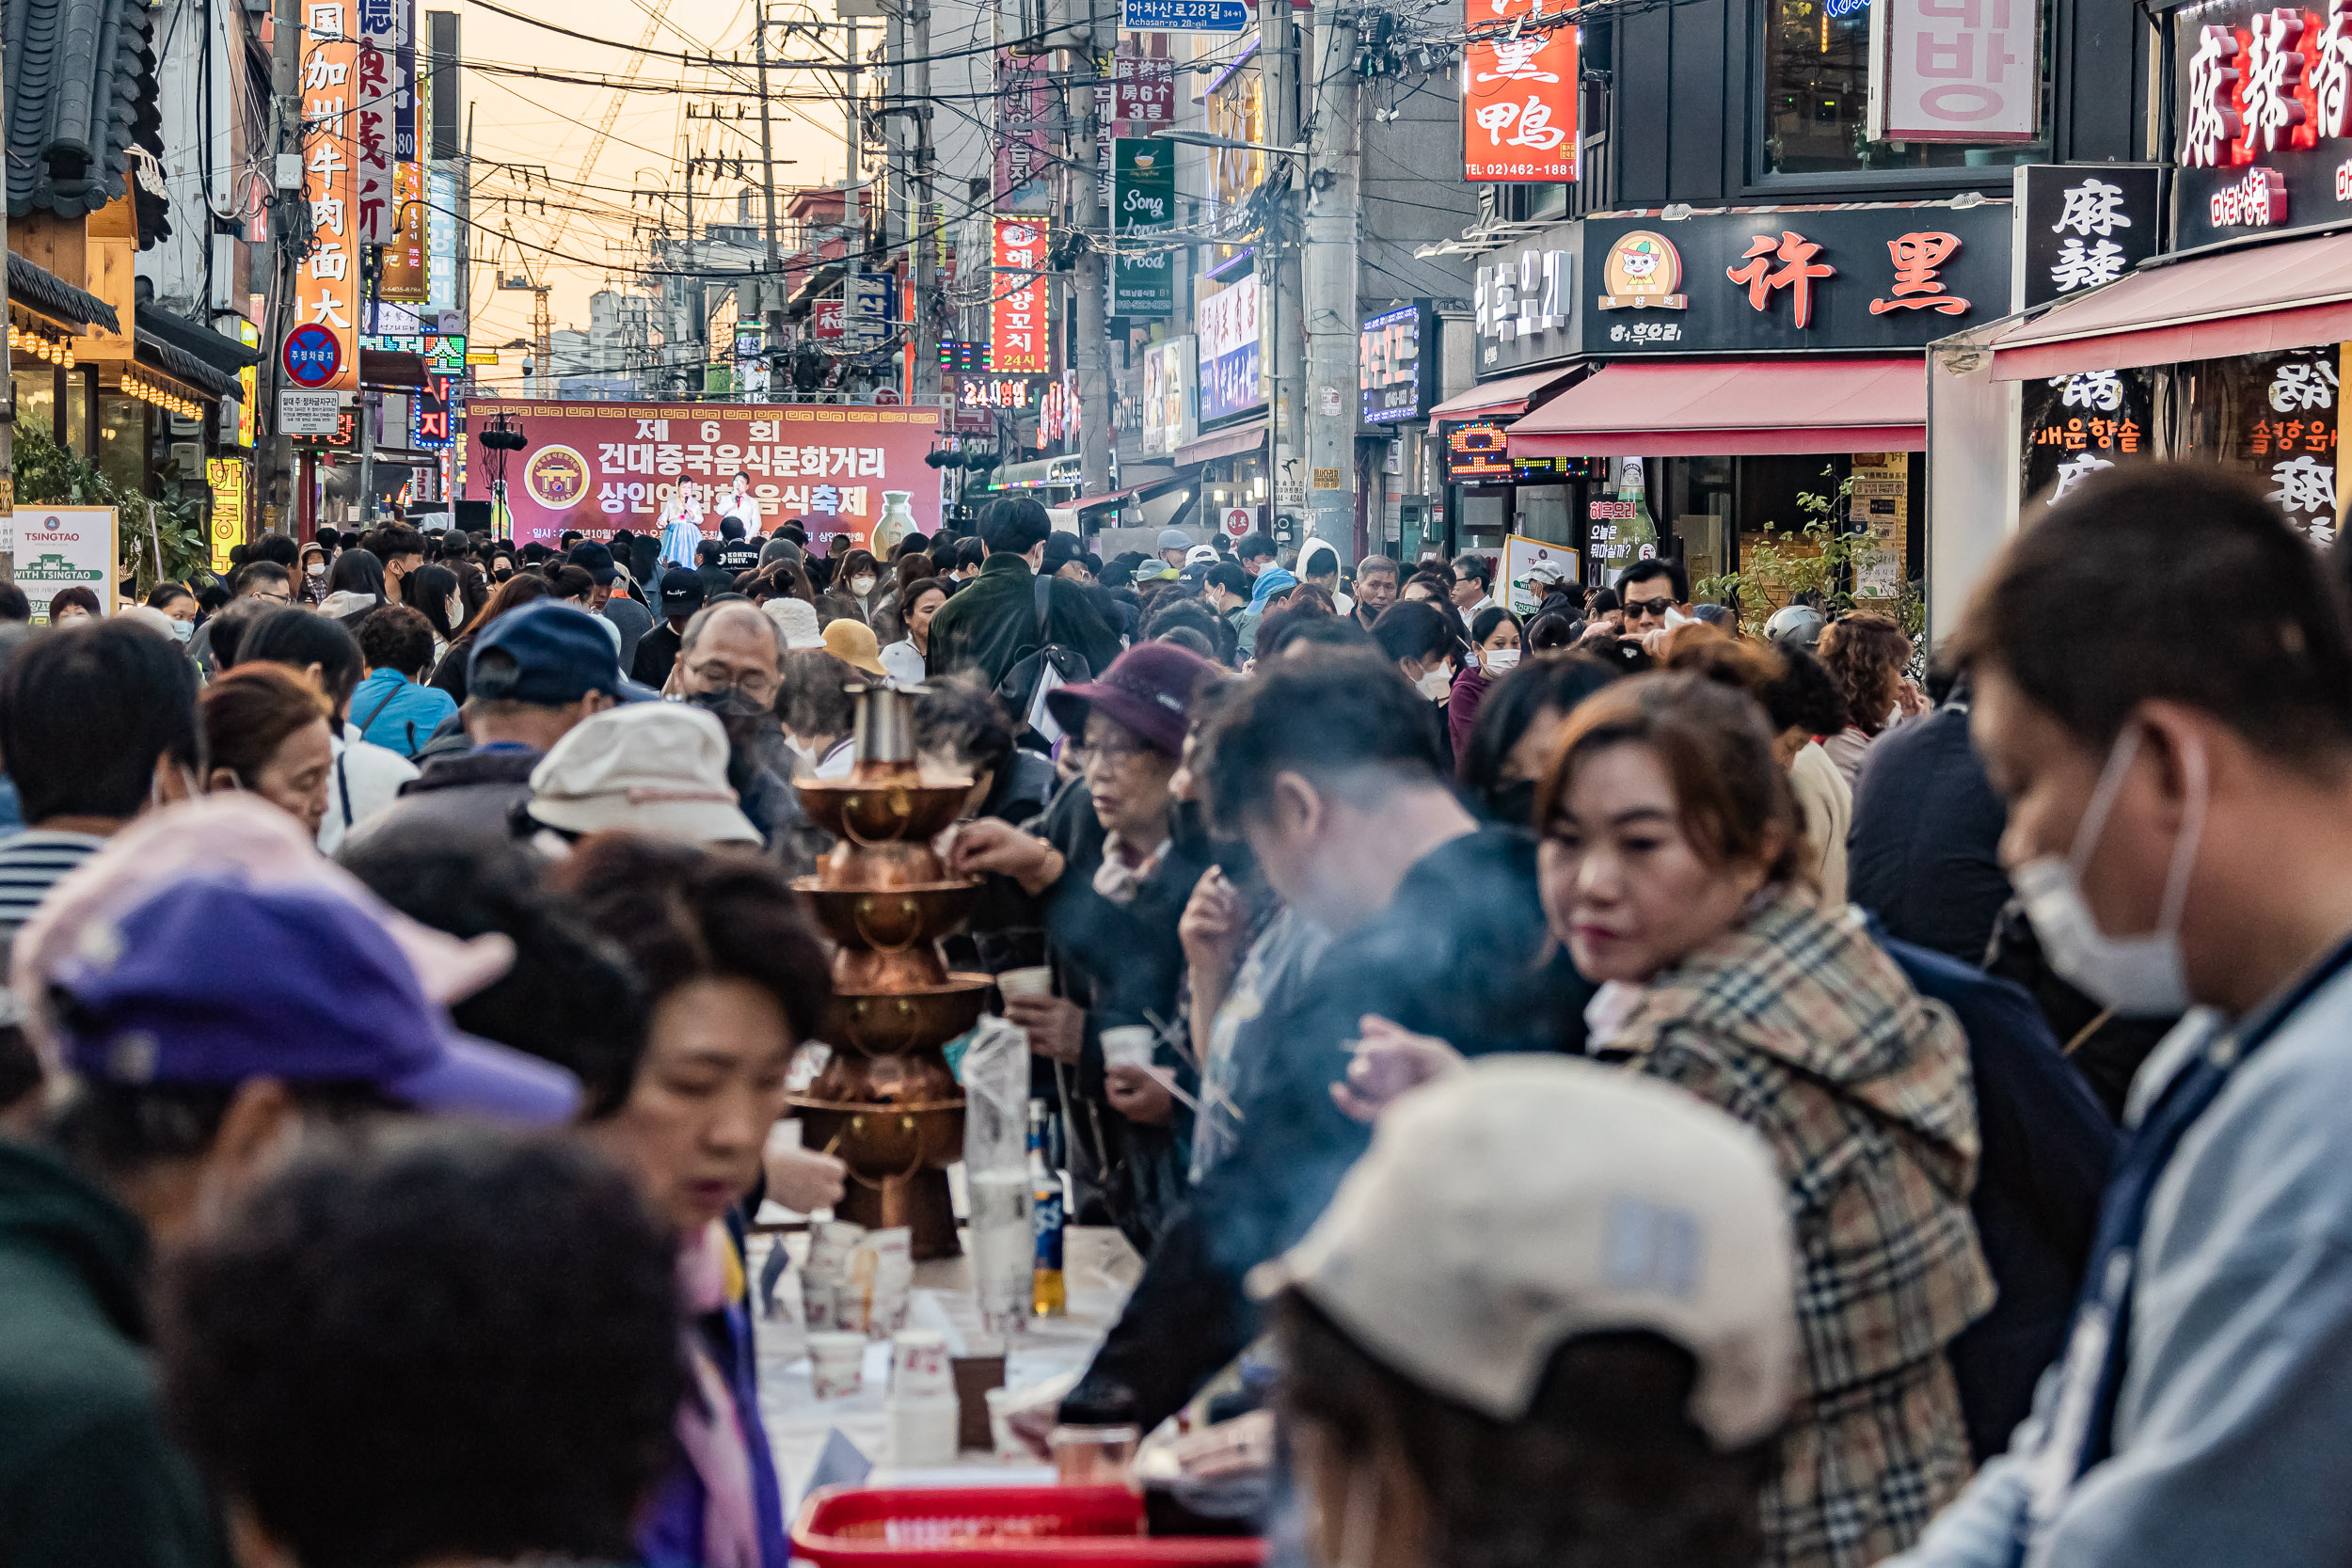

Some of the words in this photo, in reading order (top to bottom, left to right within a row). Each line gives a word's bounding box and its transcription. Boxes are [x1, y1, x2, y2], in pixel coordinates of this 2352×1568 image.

[1129, 2, 1220, 19] 아차산로28길
[1182, 20, 1207, 28] 28-gil
[1122, 85, 1169, 102] 房6个
[1129, 103, 1162, 119] 3층
[1466, 165, 1484, 174] TEL:
[1487, 164, 1574, 176] 02)462-1881
[305, 3, 352, 374] 国加州牛肉面大
[1123, 189, 1164, 219] Song
[2051, 178, 2132, 292] 麻辣
[1726, 231, 1972, 329] 许黑
[1610, 323, 1681, 345] 허흑오리
[292, 350, 333, 361] 주정차금지
[1004, 355, 1035, 367] 24시
[283, 397, 294, 405] 절대
[635, 419, 669, 442] 제
[701, 420, 721, 443] 6
[749, 420, 780, 443] 회
[597, 443, 885, 479] 건대중국음식문화거리
[755, 483, 867, 516] 음식축제
[1590, 501, 1636, 519] 허흑오리
[1229, 515, 1248, 530] 원조
[24, 532, 80, 542] TSINGTAO
[532, 529, 550, 539] 일시
[1591, 525, 1617, 540] 오늘은
[1590, 543, 1631, 559] 뭐마실까?
[41, 571, 91, 579] TSINGTAO
